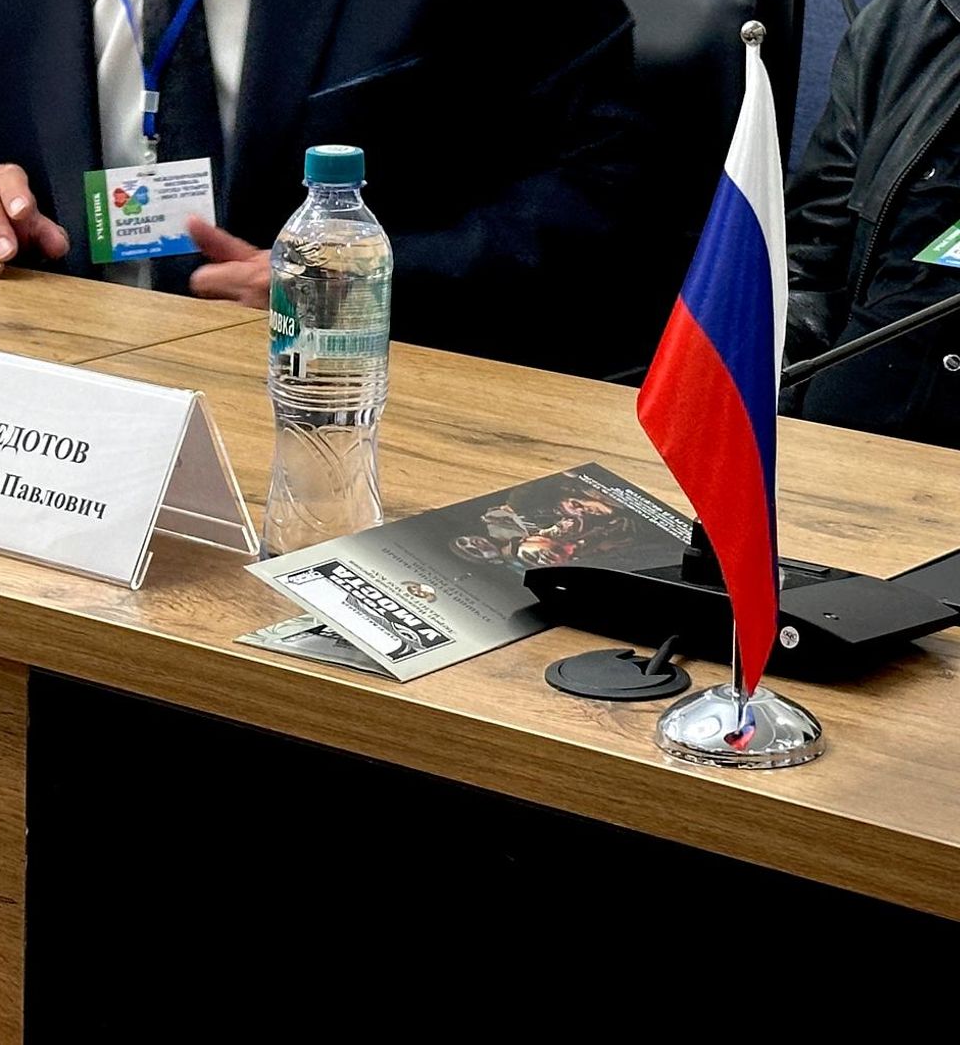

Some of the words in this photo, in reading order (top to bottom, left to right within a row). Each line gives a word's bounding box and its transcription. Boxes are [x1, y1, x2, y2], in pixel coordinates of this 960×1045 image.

[93, 193, 105, 241] УЧАСТНИК
[115, 214, 165, 226] БАРДАКОВ
[116, 225, 151, 236] СЕРГЕЙ
[332, 565, 423, 627] МОСТА
